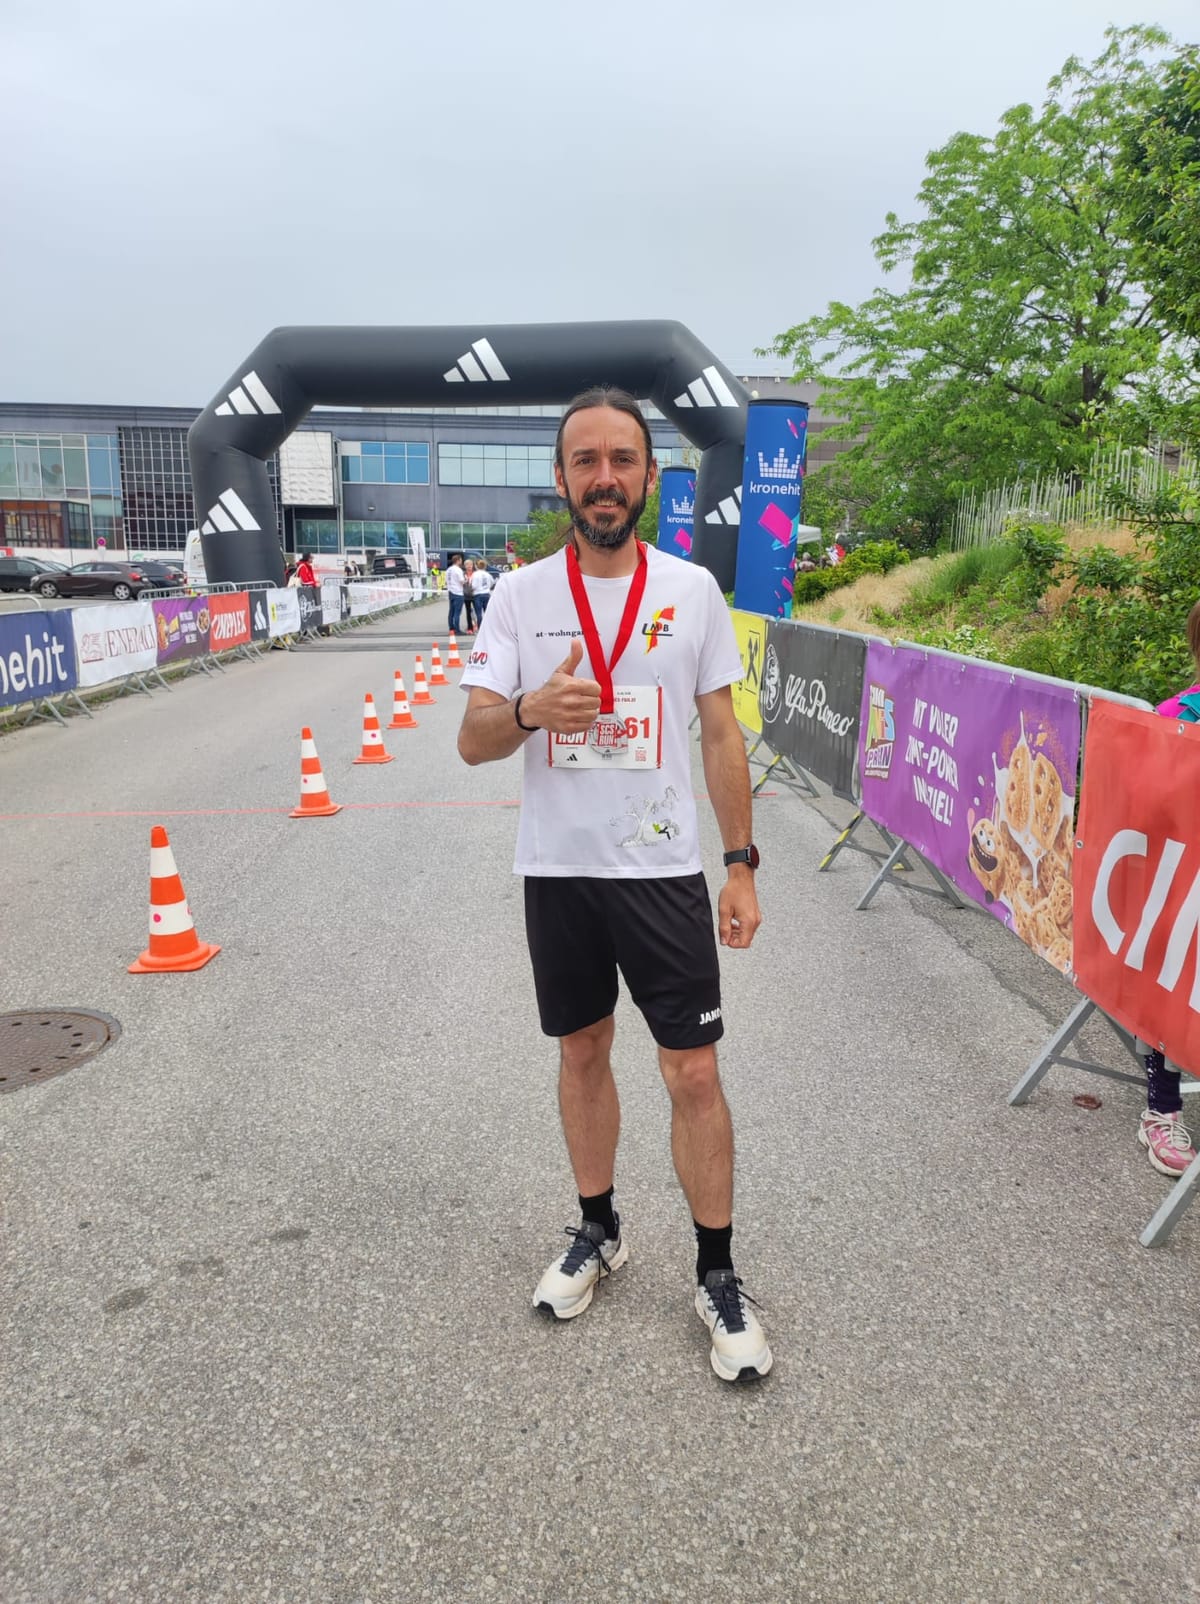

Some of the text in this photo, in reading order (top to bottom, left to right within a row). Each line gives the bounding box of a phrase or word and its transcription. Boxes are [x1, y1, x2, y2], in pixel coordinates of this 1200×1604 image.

[750, 481, 800, 496] kronehit
[104, 624, 156, 657] ENERALI
[785, 673, 854, 737] Alfa Romeo
[616, 716, 650, 739] 61
